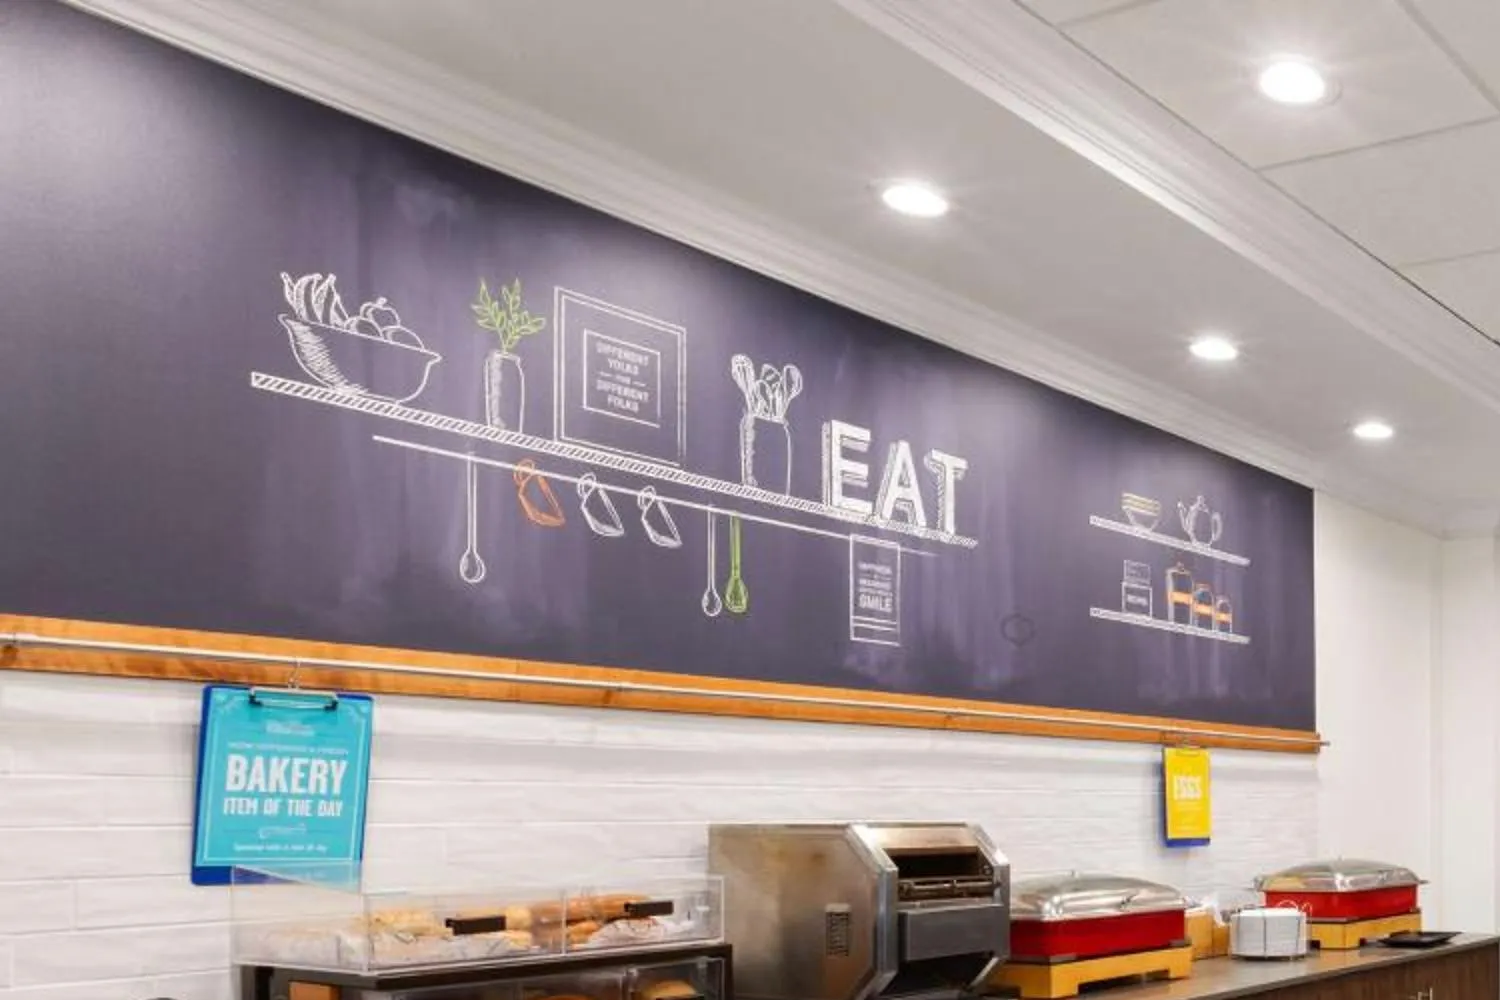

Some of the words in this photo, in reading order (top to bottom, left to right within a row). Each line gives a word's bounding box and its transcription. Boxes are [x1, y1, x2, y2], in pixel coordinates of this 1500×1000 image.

[822, 419, 969, 535] EAT
[225, 753, 348, 796] BAKERY
[223, 797, 260, 815] ITEM
[263, 798, 282, 816] OF
[288, 799, 313, 817] THE
[317, 800, 344, 817] DAY
